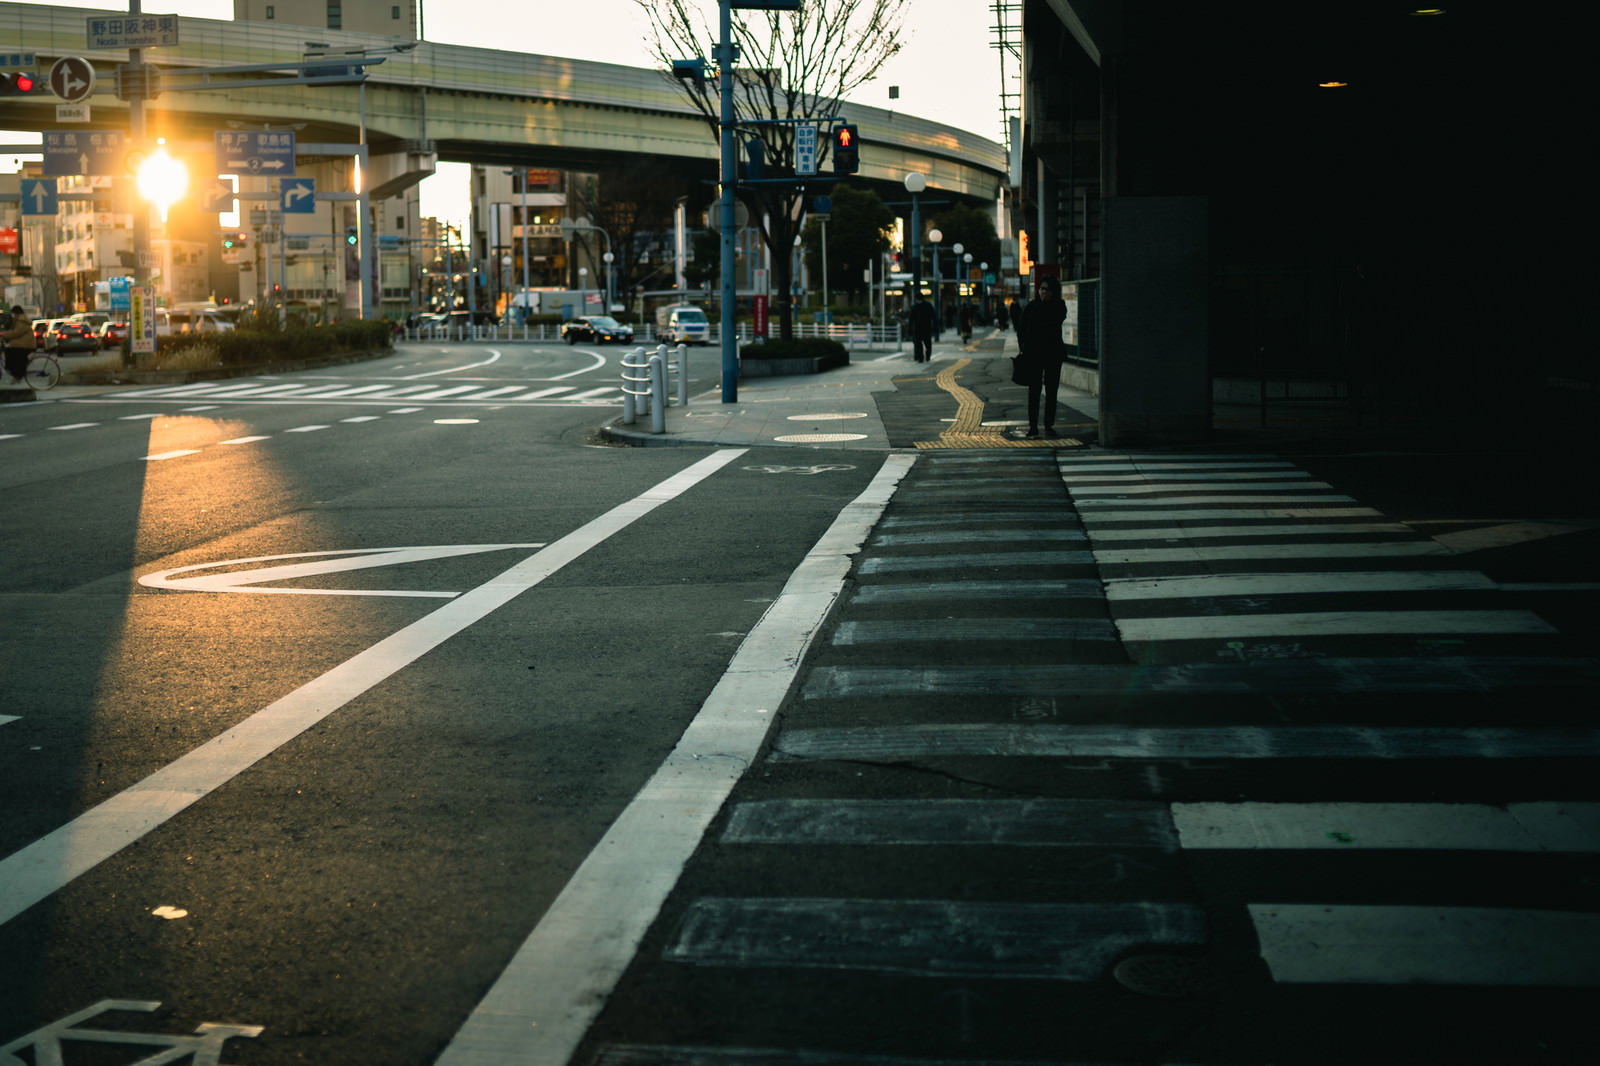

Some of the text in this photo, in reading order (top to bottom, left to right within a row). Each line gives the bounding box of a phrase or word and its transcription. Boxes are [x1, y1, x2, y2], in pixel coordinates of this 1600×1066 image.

[92, 17, 173, 35] 野田阪神東
